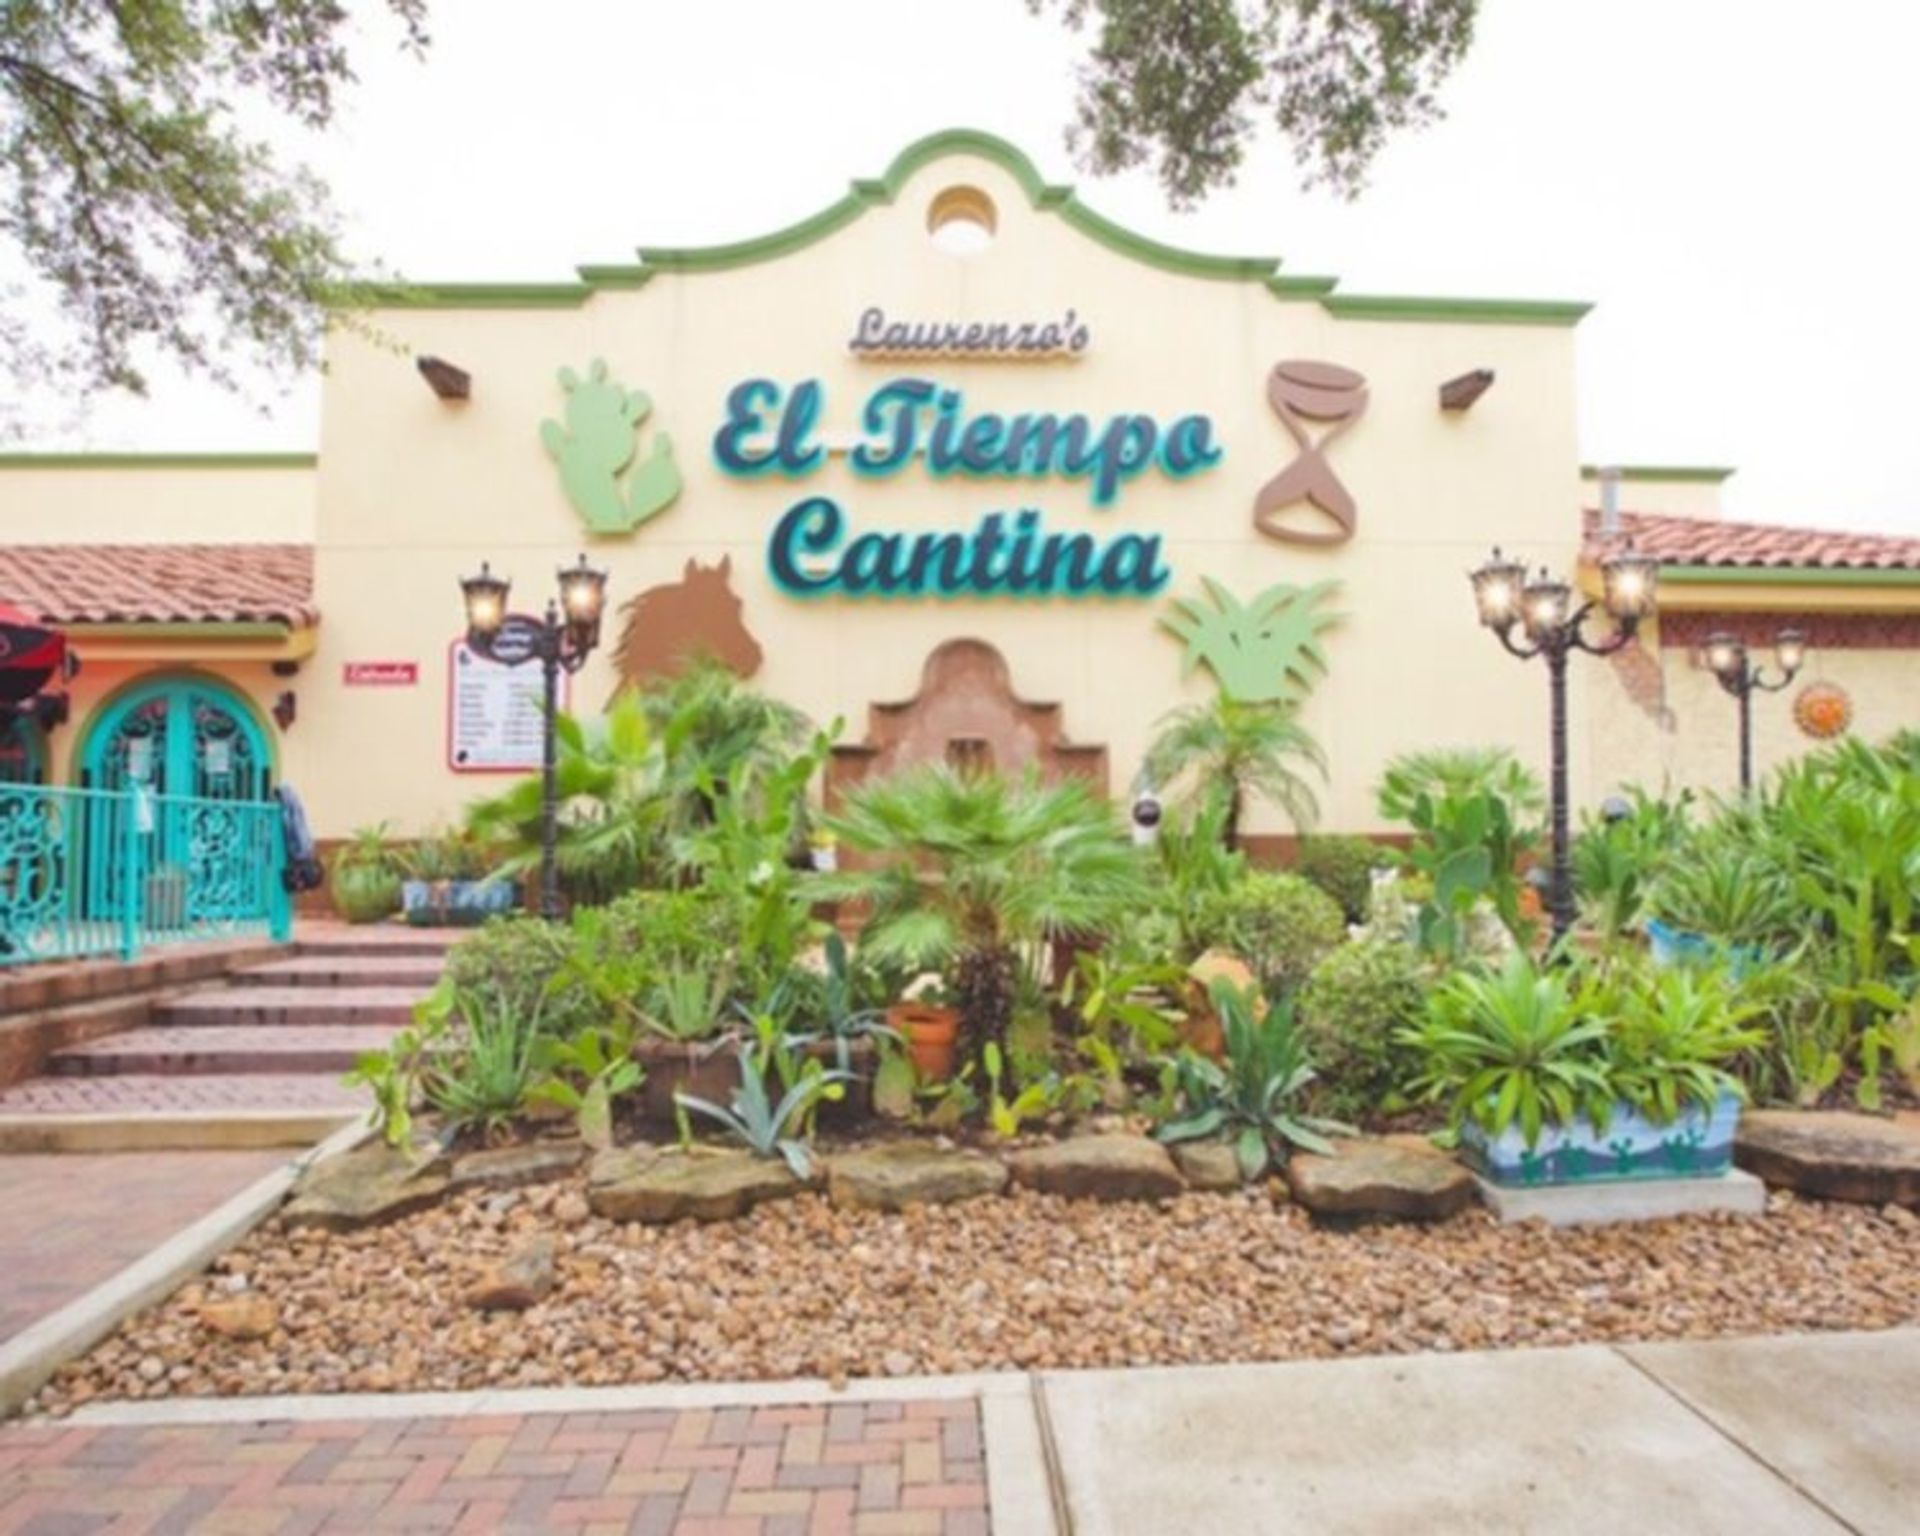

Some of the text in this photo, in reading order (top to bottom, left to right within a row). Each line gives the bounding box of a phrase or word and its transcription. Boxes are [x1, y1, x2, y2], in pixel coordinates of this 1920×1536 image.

[848, 307, 1091, 355] Laurenzo's
[712, 376, 1223, 506] El Tiempo
[767, 496, 1171, 598] Cantina
